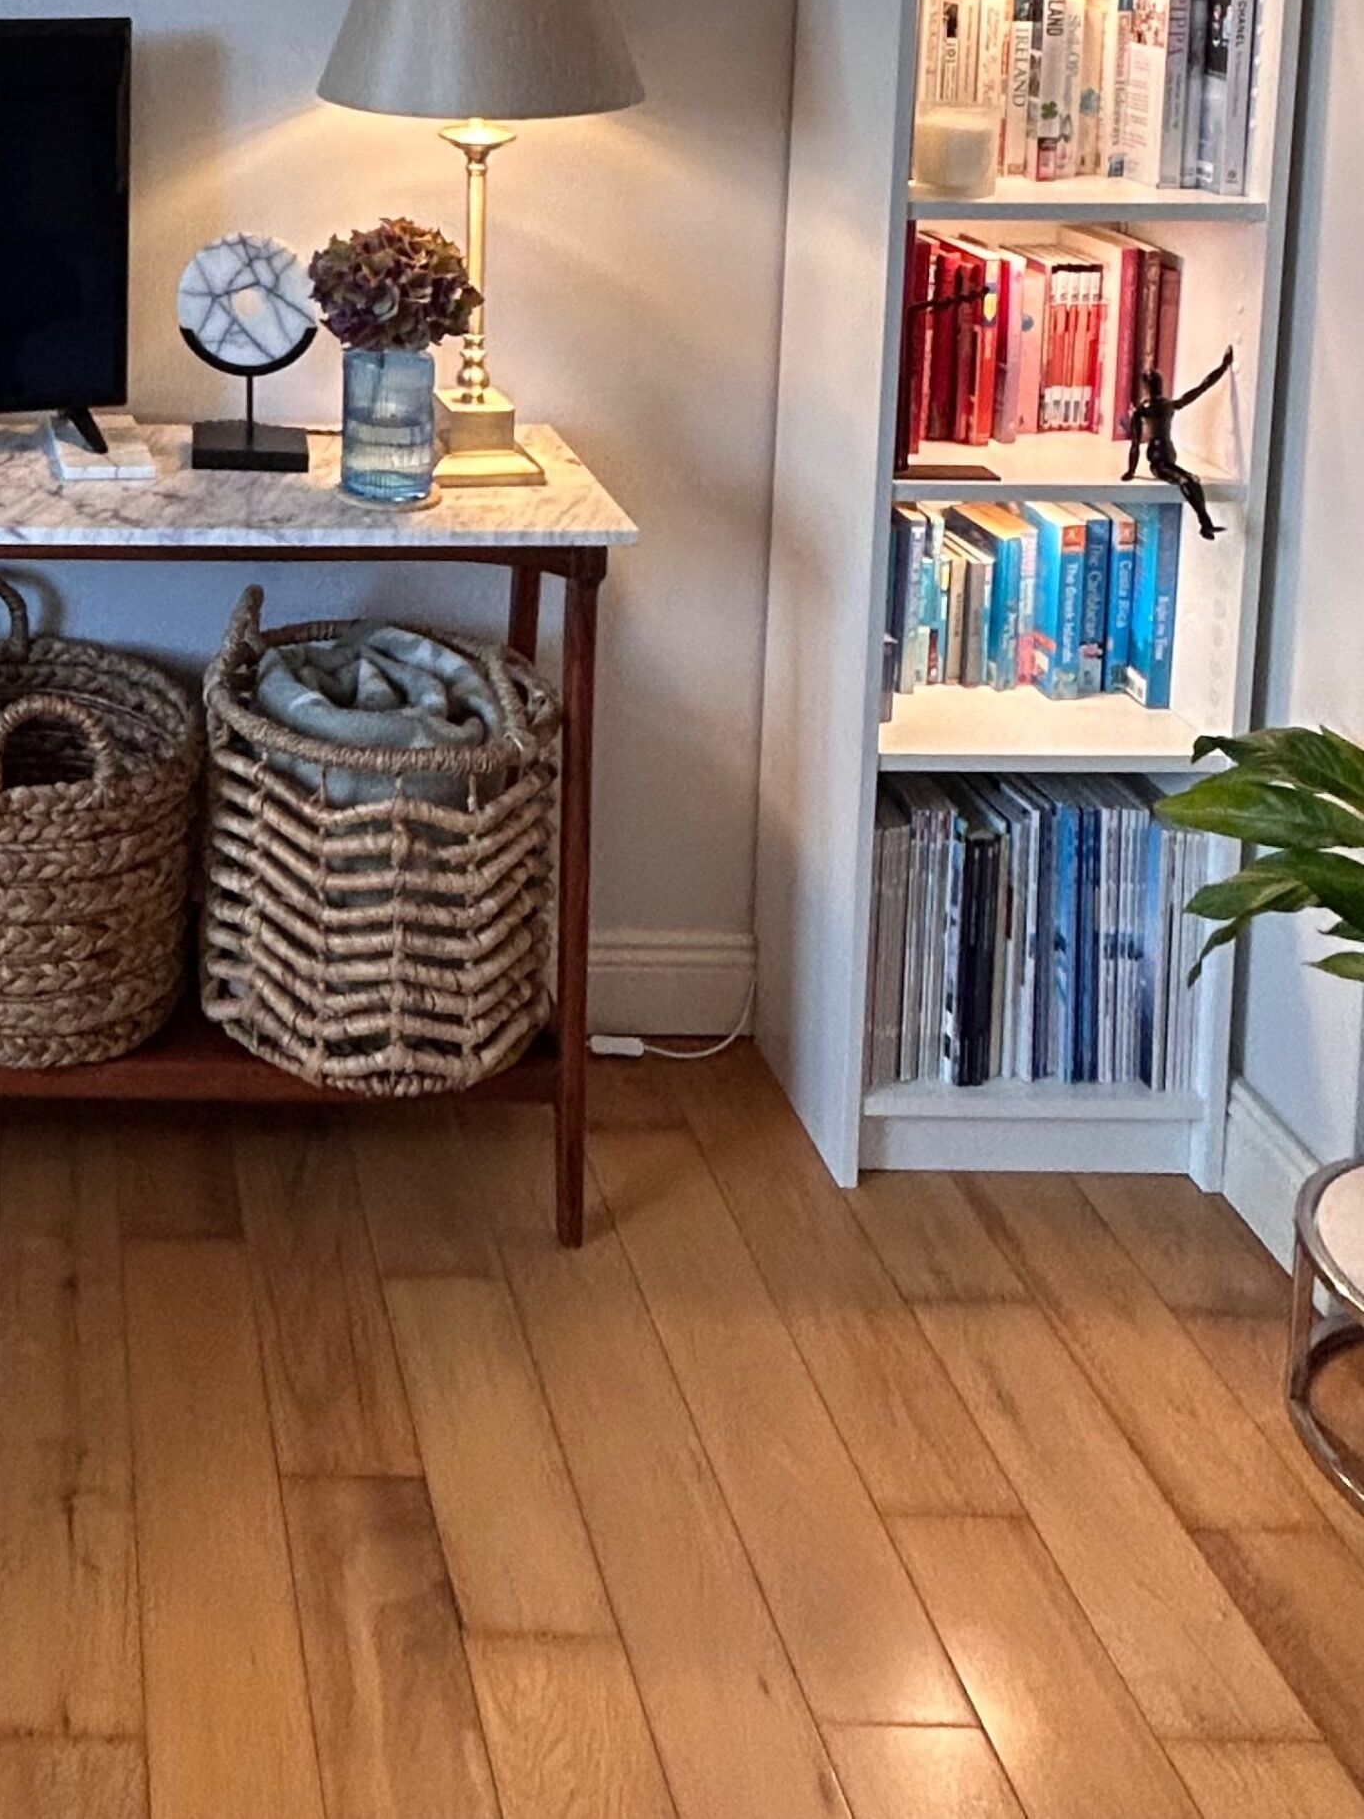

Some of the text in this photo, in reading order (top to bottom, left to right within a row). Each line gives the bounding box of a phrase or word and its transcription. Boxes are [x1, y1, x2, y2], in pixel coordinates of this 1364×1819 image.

[1235, 0, 1248, 48] CHANEL
[1012, 28, 1030, 108] IRELAND
[1065, 563, 1078, 583] The
[1085, 570, 1102, 638] Caribbean
[1116, 560, 1132, 629] Costa Rica
